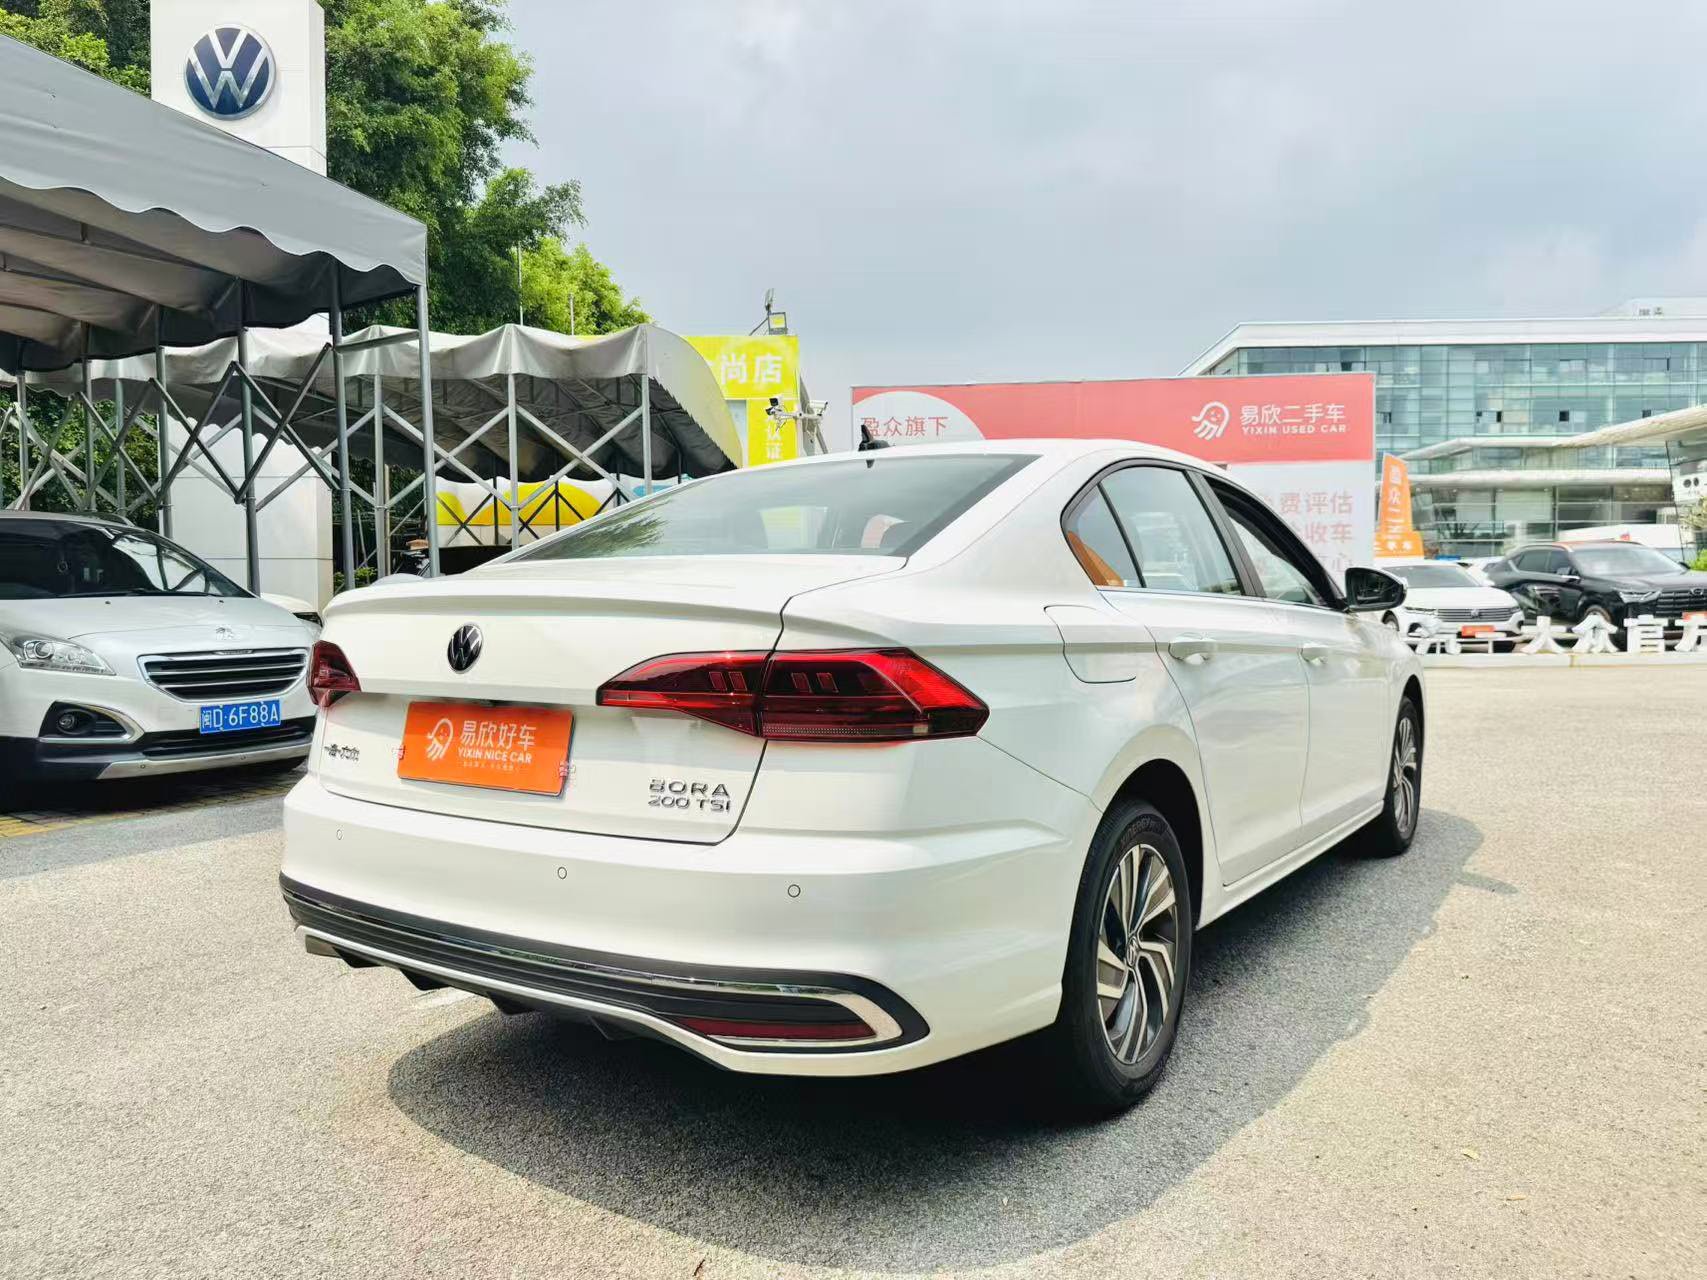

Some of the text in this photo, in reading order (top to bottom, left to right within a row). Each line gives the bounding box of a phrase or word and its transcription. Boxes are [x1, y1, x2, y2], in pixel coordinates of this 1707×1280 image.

[706, 352, 783, 385] 尚店
[1240, 403, 1346, 426] 易欣二手车
[861, 415, 949, 437] 盈众旗下
[1241, 424, 1347, 435] YIXIN USED CAR
[459, 720, 537, 751] 易欣好车
[457, 747, 533, 765] YIXIN NICE CAR
[649, 778, 730, 797] BORA
[648, 795, 731, 812] 200 TSI
